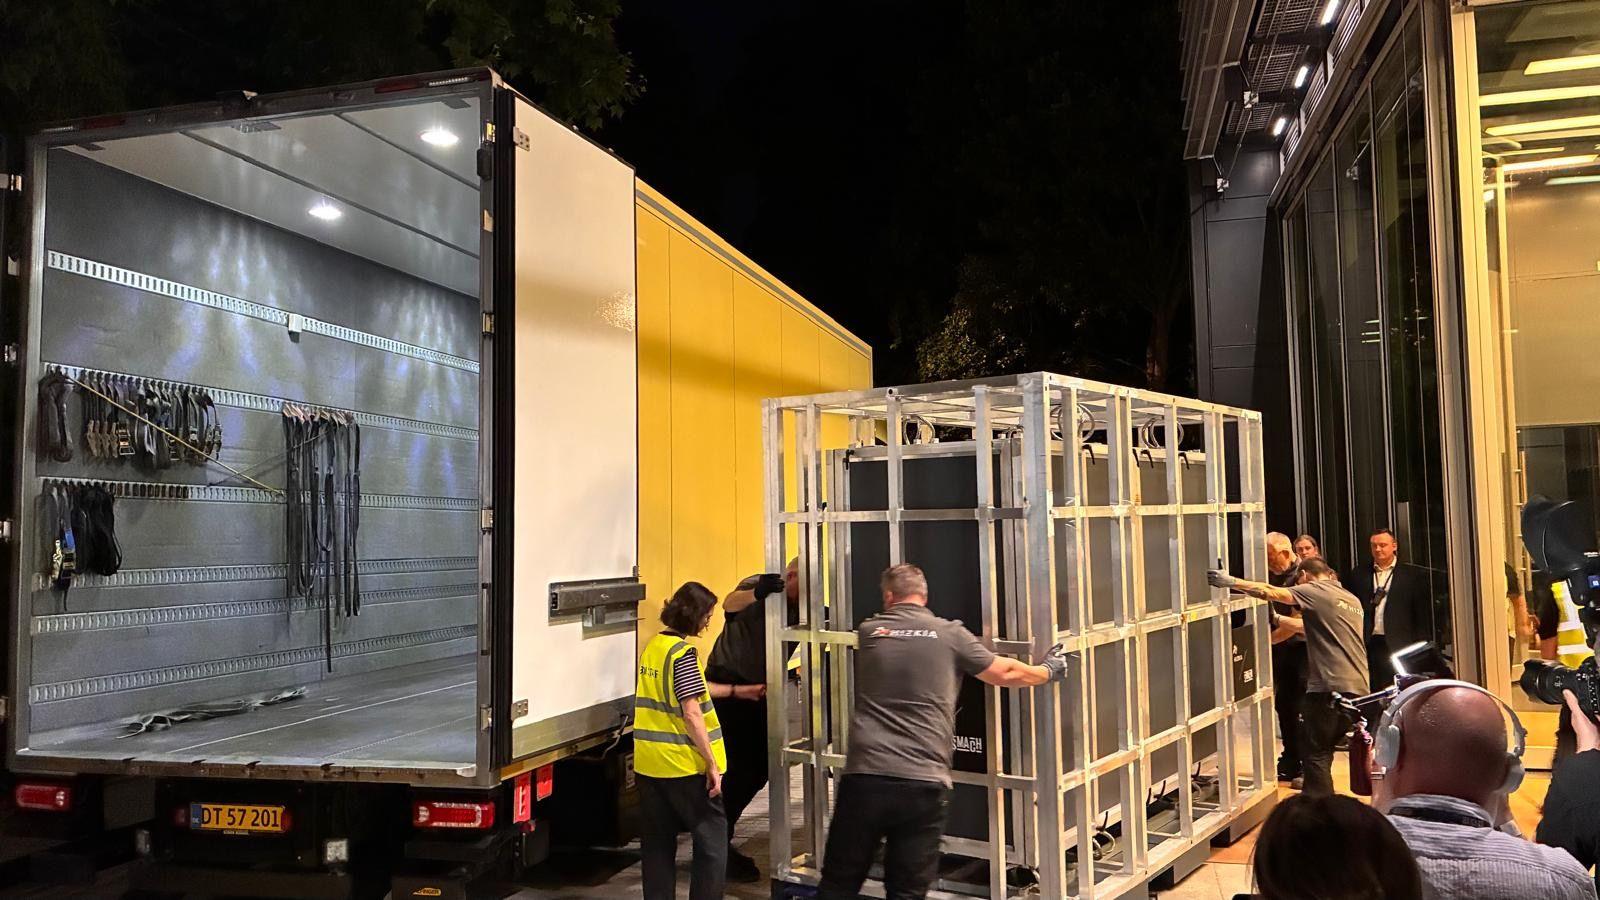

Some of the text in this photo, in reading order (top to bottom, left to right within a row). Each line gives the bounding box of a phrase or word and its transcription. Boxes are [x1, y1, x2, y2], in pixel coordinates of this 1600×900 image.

[201, 807, 279, 828] DT 57 201
